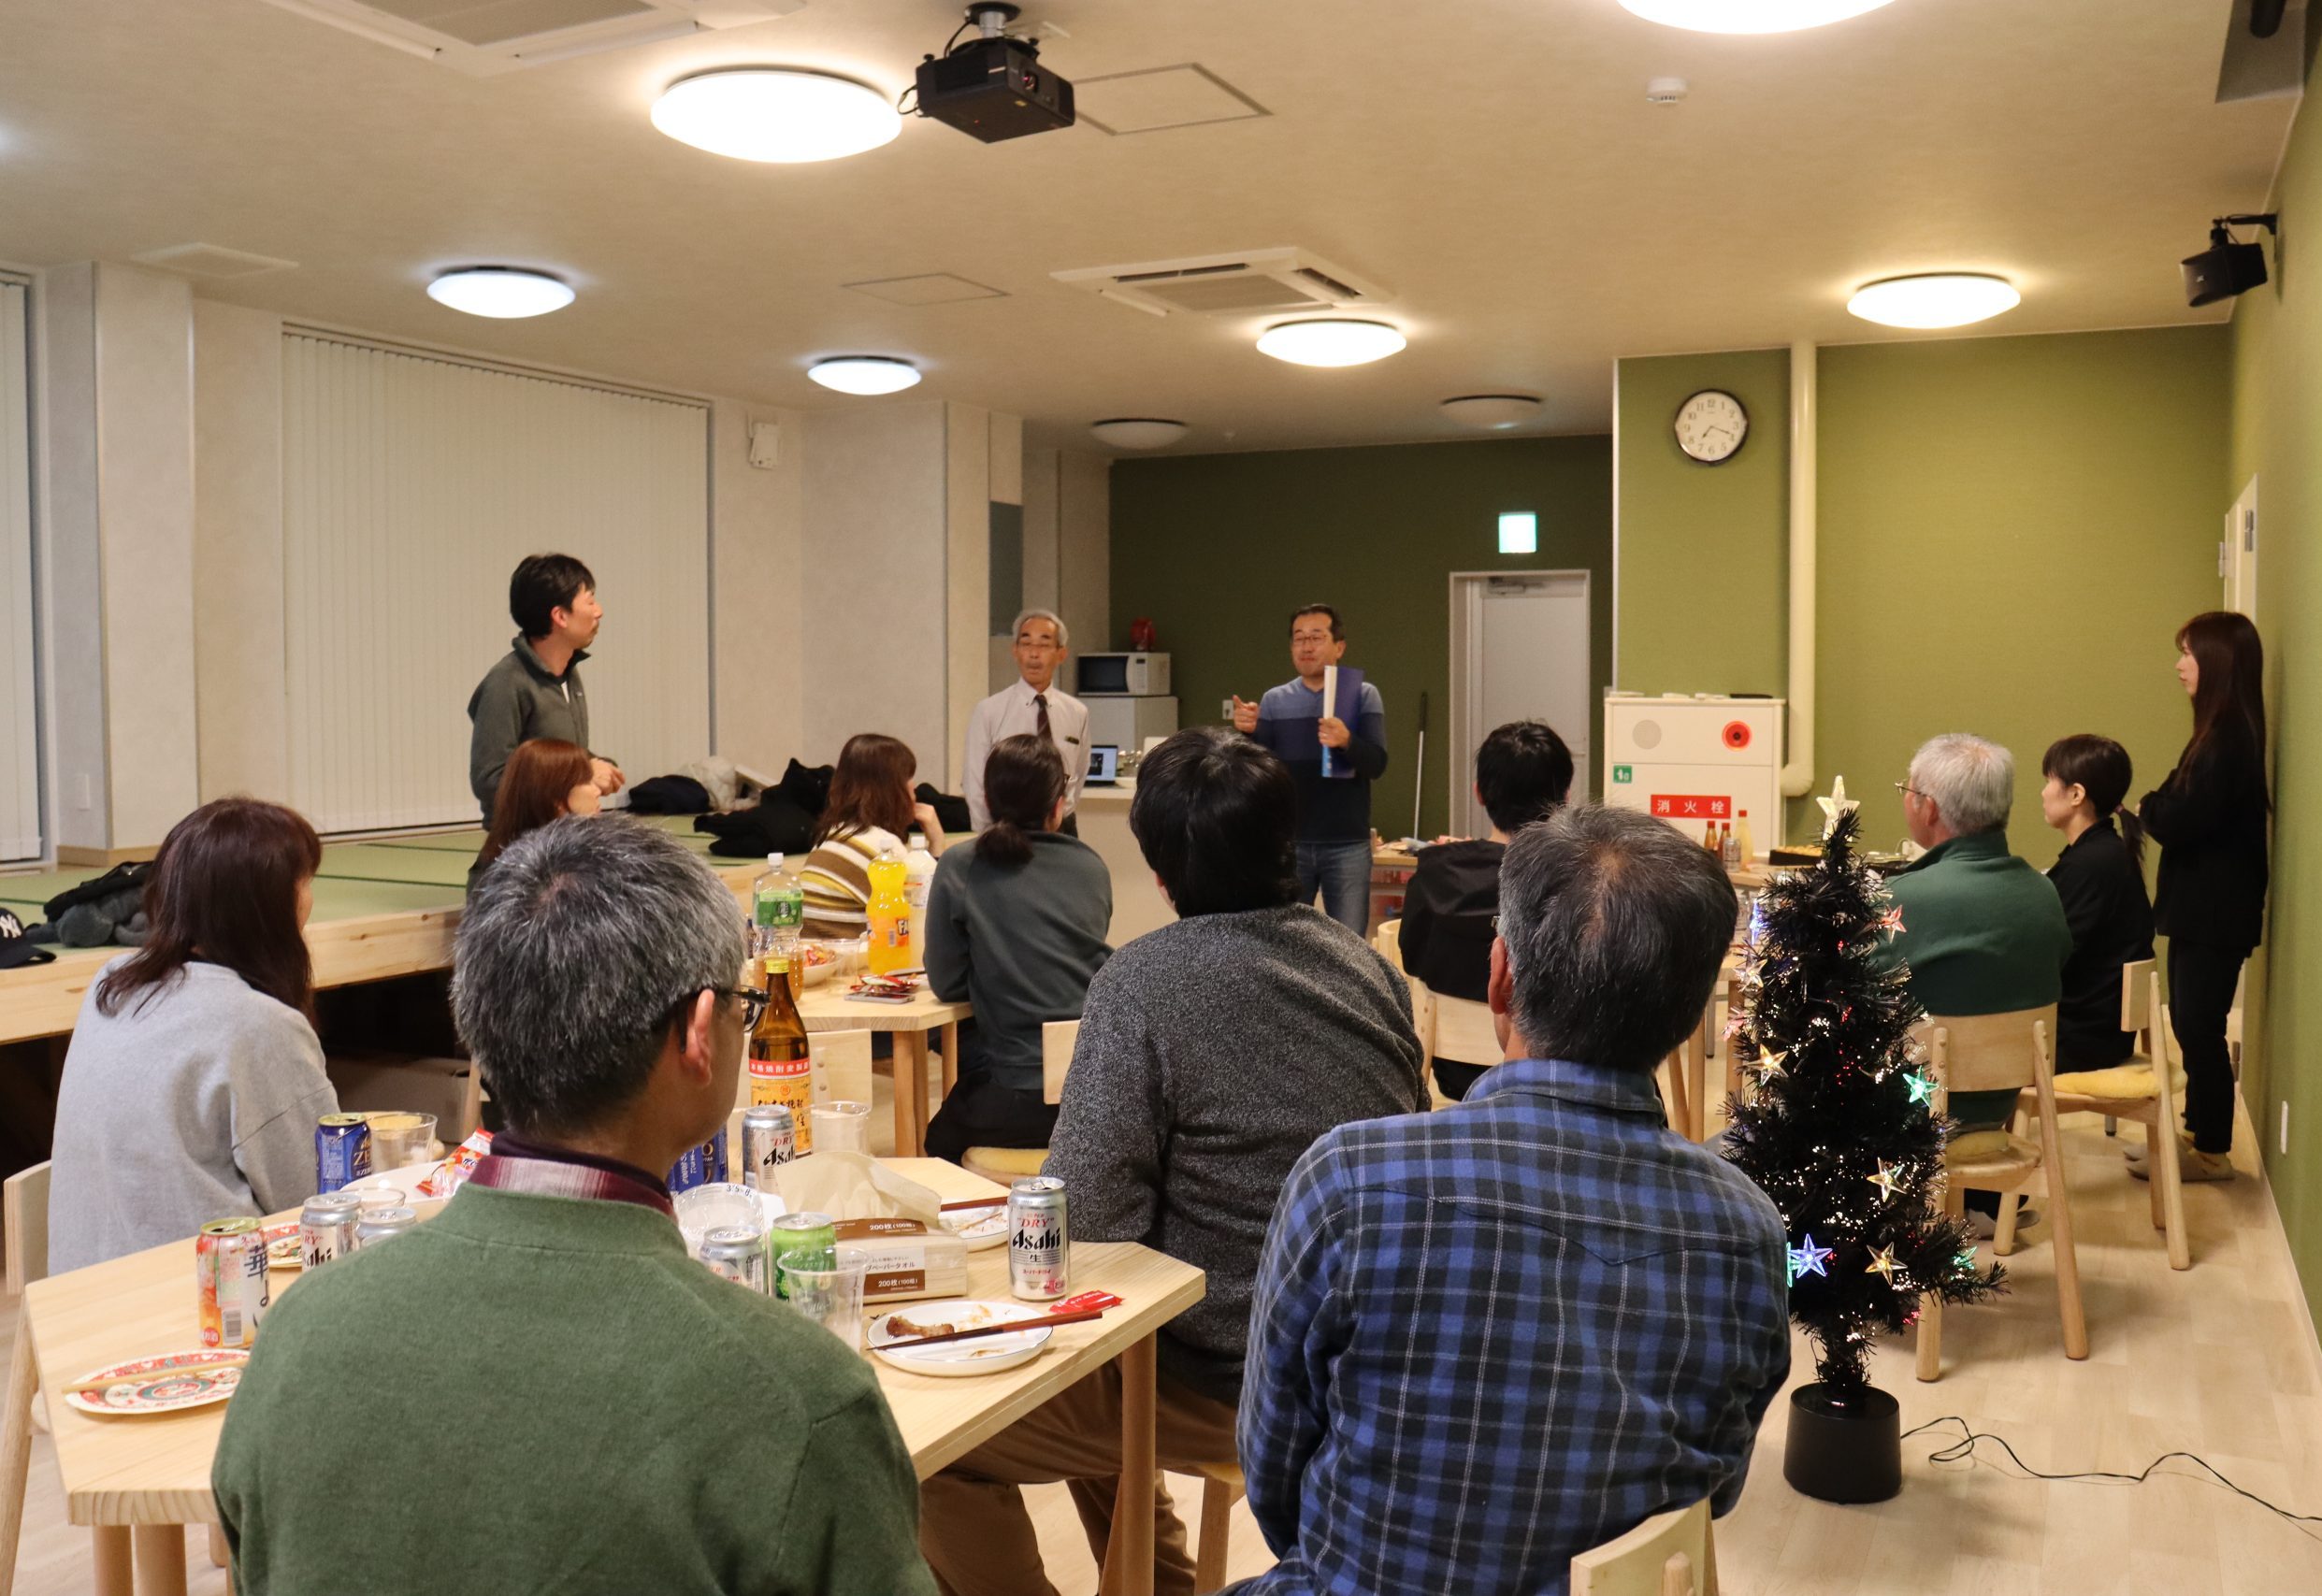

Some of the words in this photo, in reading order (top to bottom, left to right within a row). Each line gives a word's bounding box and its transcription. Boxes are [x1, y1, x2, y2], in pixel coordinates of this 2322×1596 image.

[1696, 403, 1704, 411] 11
[1708, 399, 1715, 408] 12
[1729, 410, 1735, 418] 2
[1734, 422, 1739, 430] 3
[1698, 443, 1704, 452] 7
[1709, 446, 1714, 454] 6
[1657, 799, 1724, 814] 消火栓
[1012, 1227, 1060, 1250] Asahi
